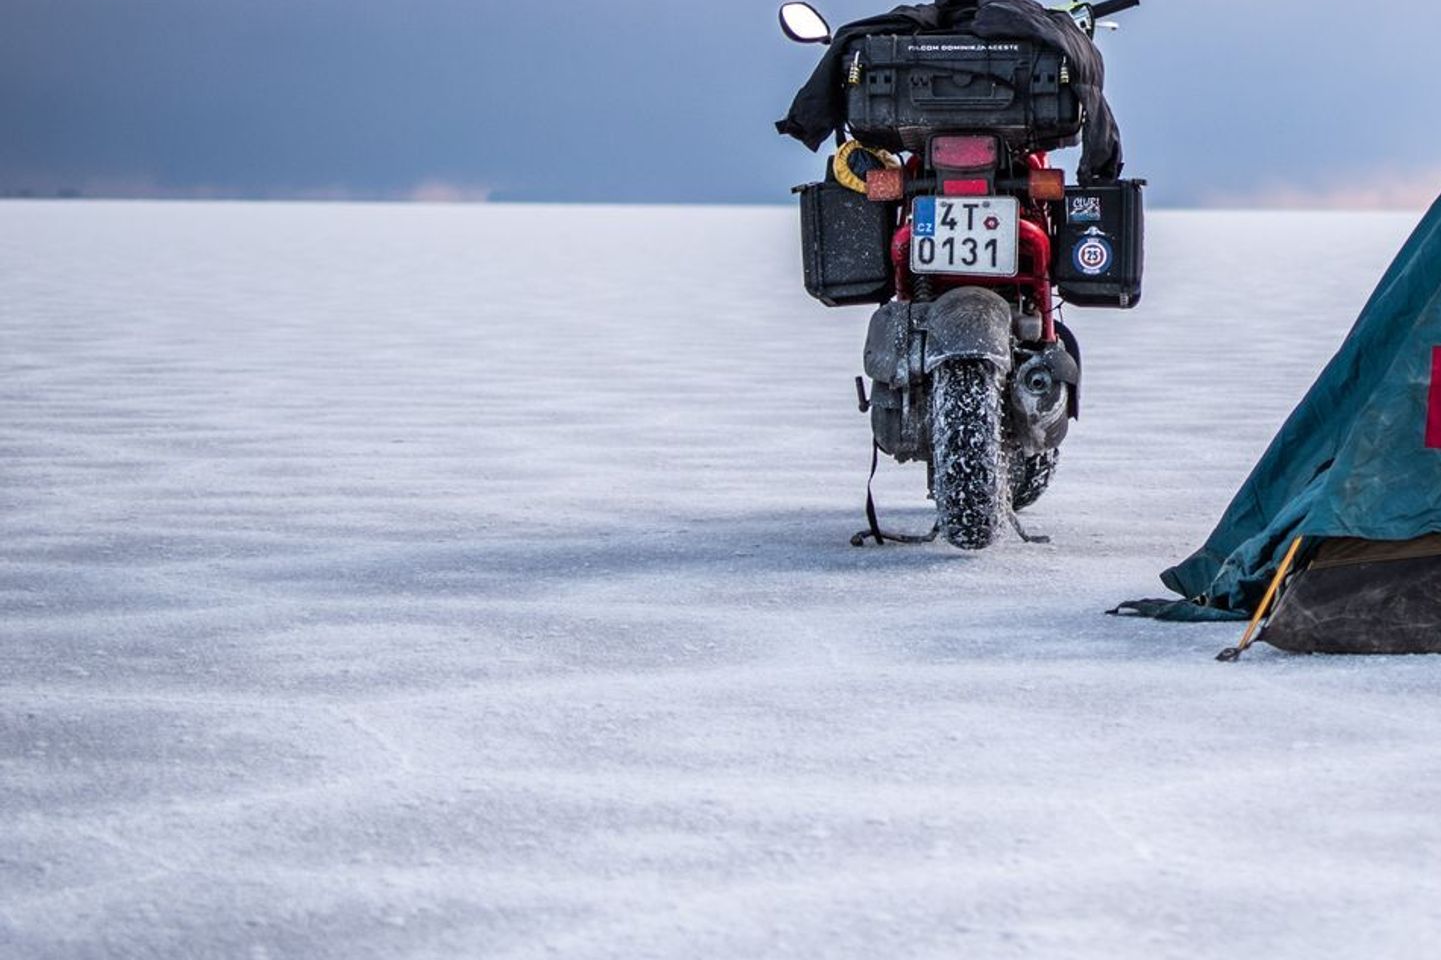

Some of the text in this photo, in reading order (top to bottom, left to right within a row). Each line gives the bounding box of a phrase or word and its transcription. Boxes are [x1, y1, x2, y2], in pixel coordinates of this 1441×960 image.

[917, 223, 933, 232] CZ
[940, 203, 979, 231] 4T
[918, 236, 998, 268] 0131
